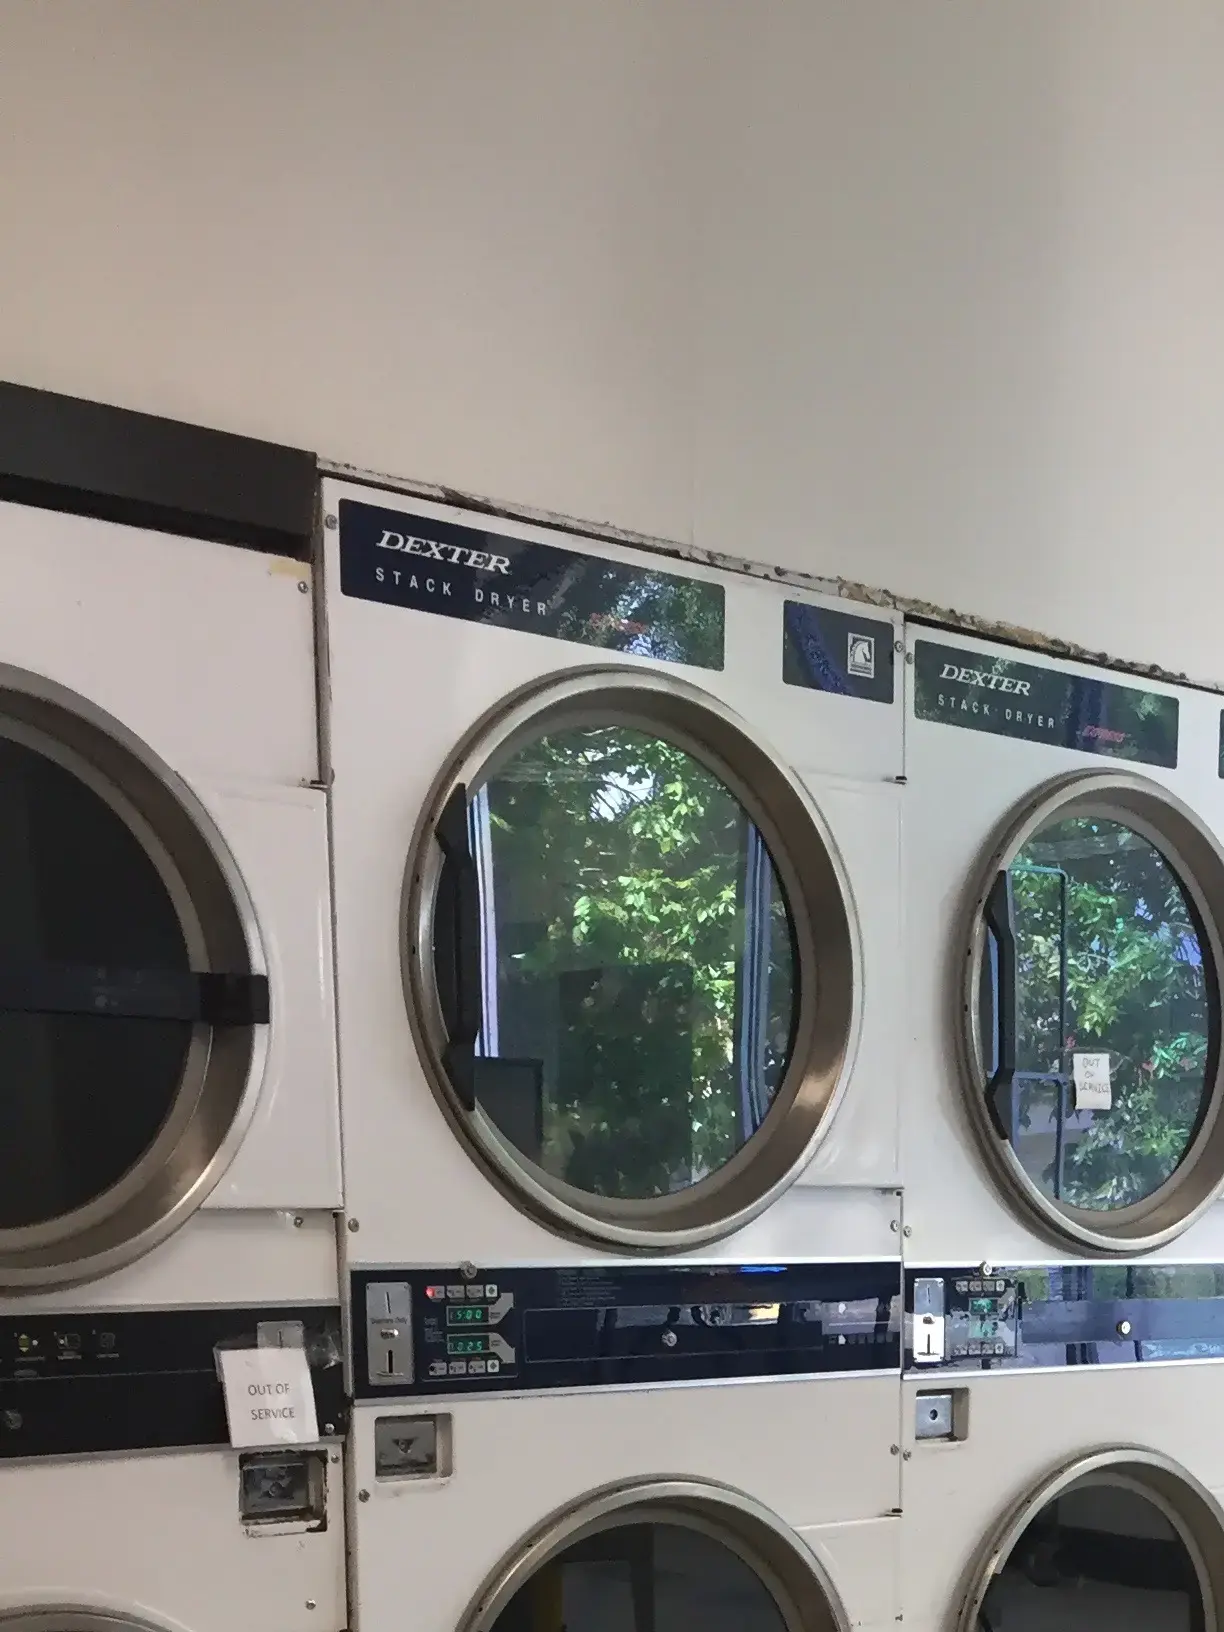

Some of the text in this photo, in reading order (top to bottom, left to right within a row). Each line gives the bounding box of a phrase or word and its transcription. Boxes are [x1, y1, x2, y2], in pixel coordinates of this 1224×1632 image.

[376, 530, 512, 575] DEXTER
[375, 567, 546, 616] STACK DRYER
[940, 664, 1031, 696] DEXTER
[938, 694, 1055, 728] STACK DRYER
[247, 1383, 290, 1396] OUT OF
[250, 1407, 295, 1421] SERVICE
